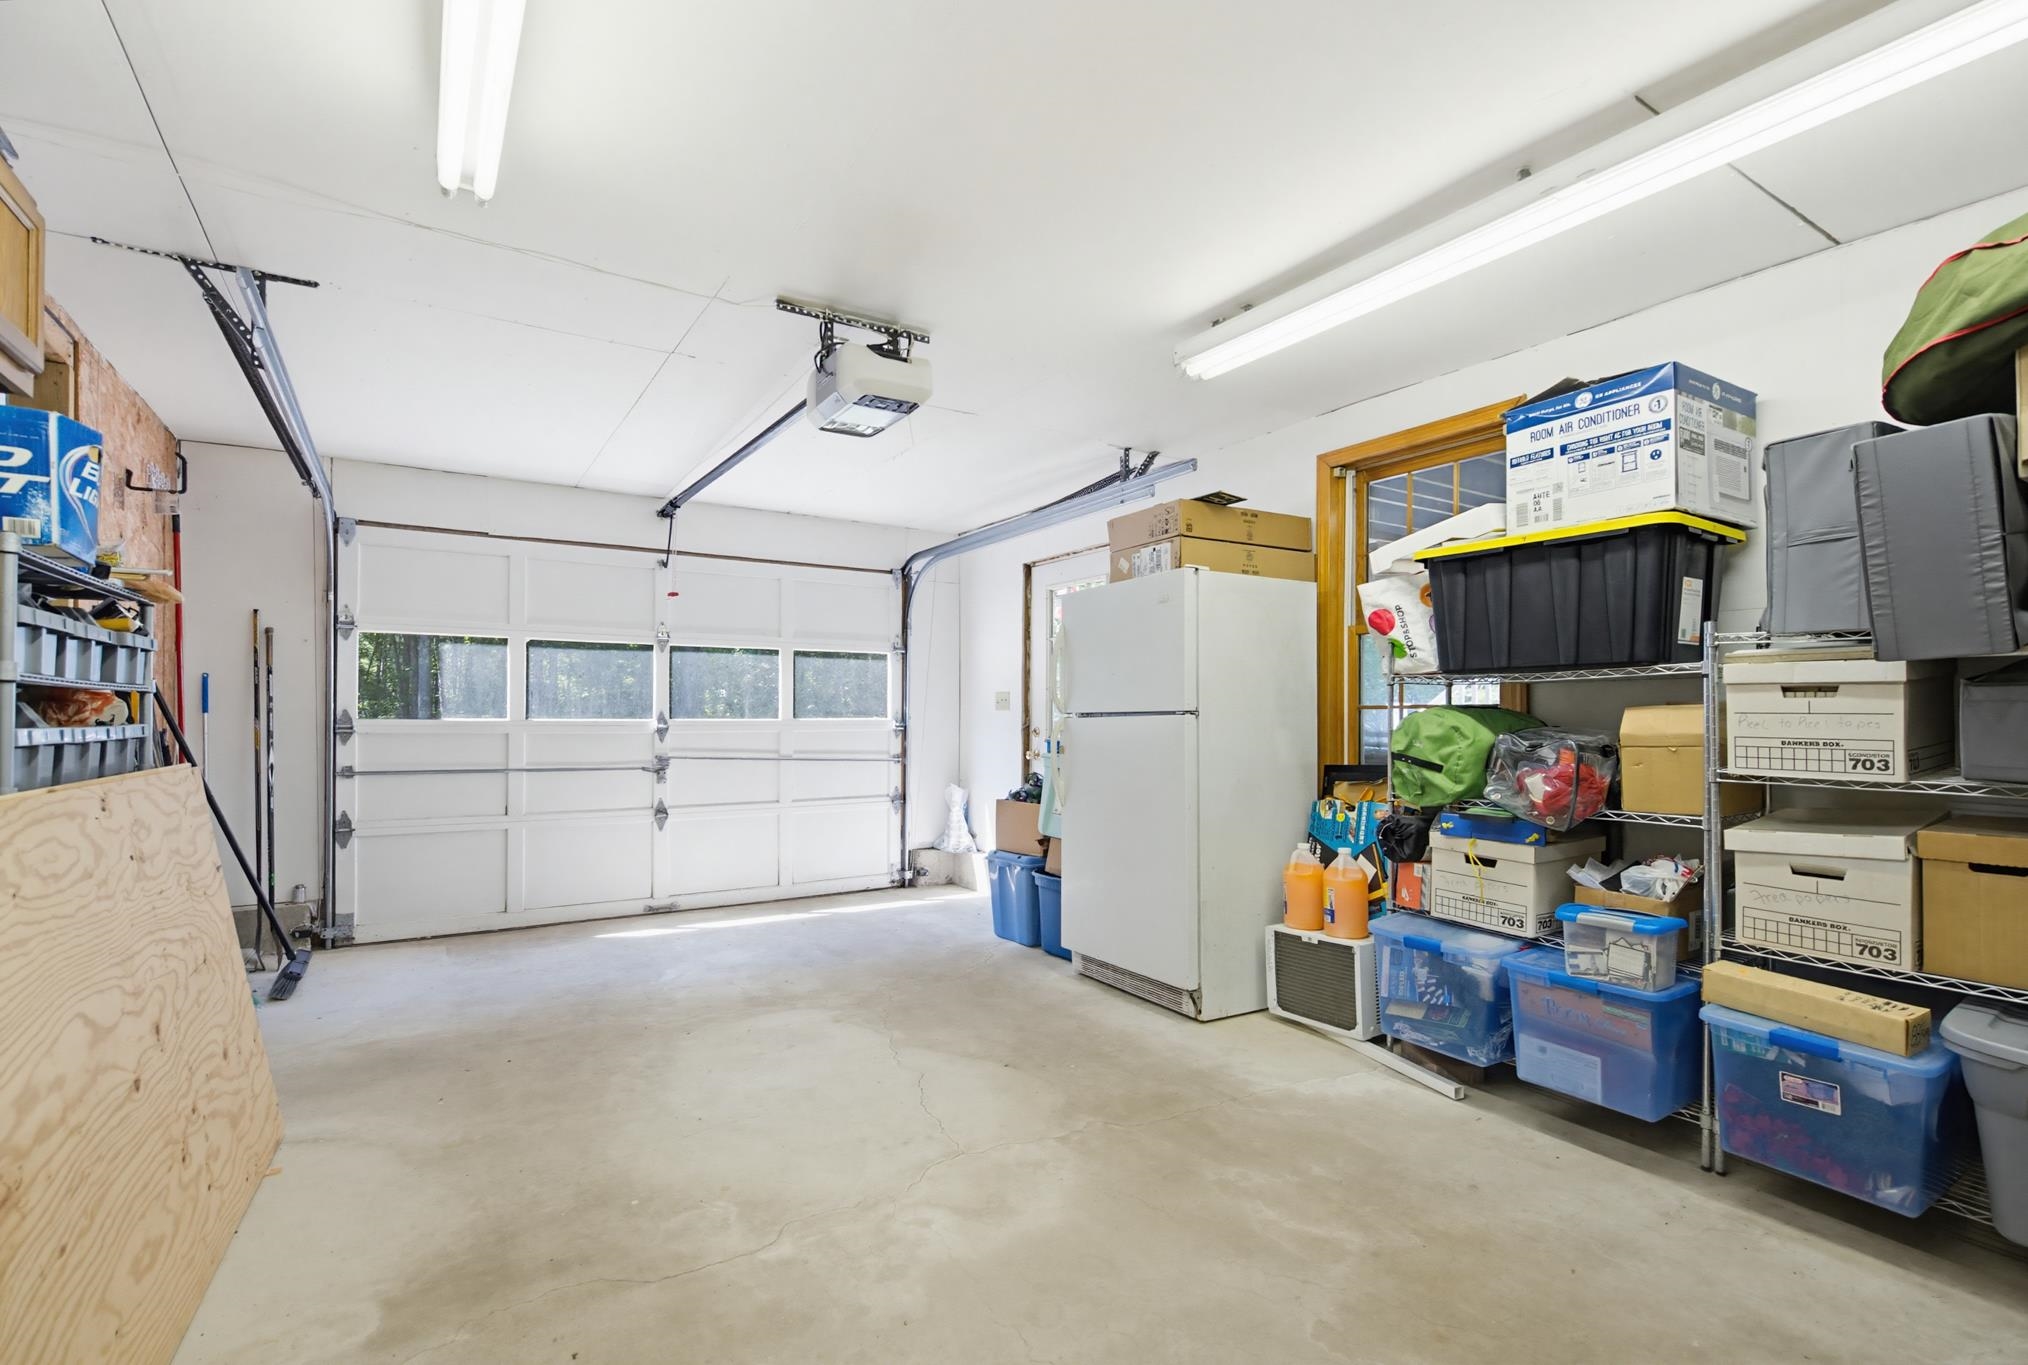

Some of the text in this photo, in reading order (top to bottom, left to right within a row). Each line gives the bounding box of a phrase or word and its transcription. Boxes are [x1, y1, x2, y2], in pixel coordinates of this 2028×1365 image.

[1530, 427, 1554, 443] ROOM
[1559, 421, 1573, 435] AIR
[1578, 403, 1640, 430] CONDITIONER
[1780, 740, 1820, 748] BANKERS
[1849, 758, 1890, 772] 703
[1500, 914, 1524, 929] 703
[1538, 918, 1552, 931] 703
[1788, 917, 1827, 928] BANKERS
[1856, 942, 1897, 961] 703
